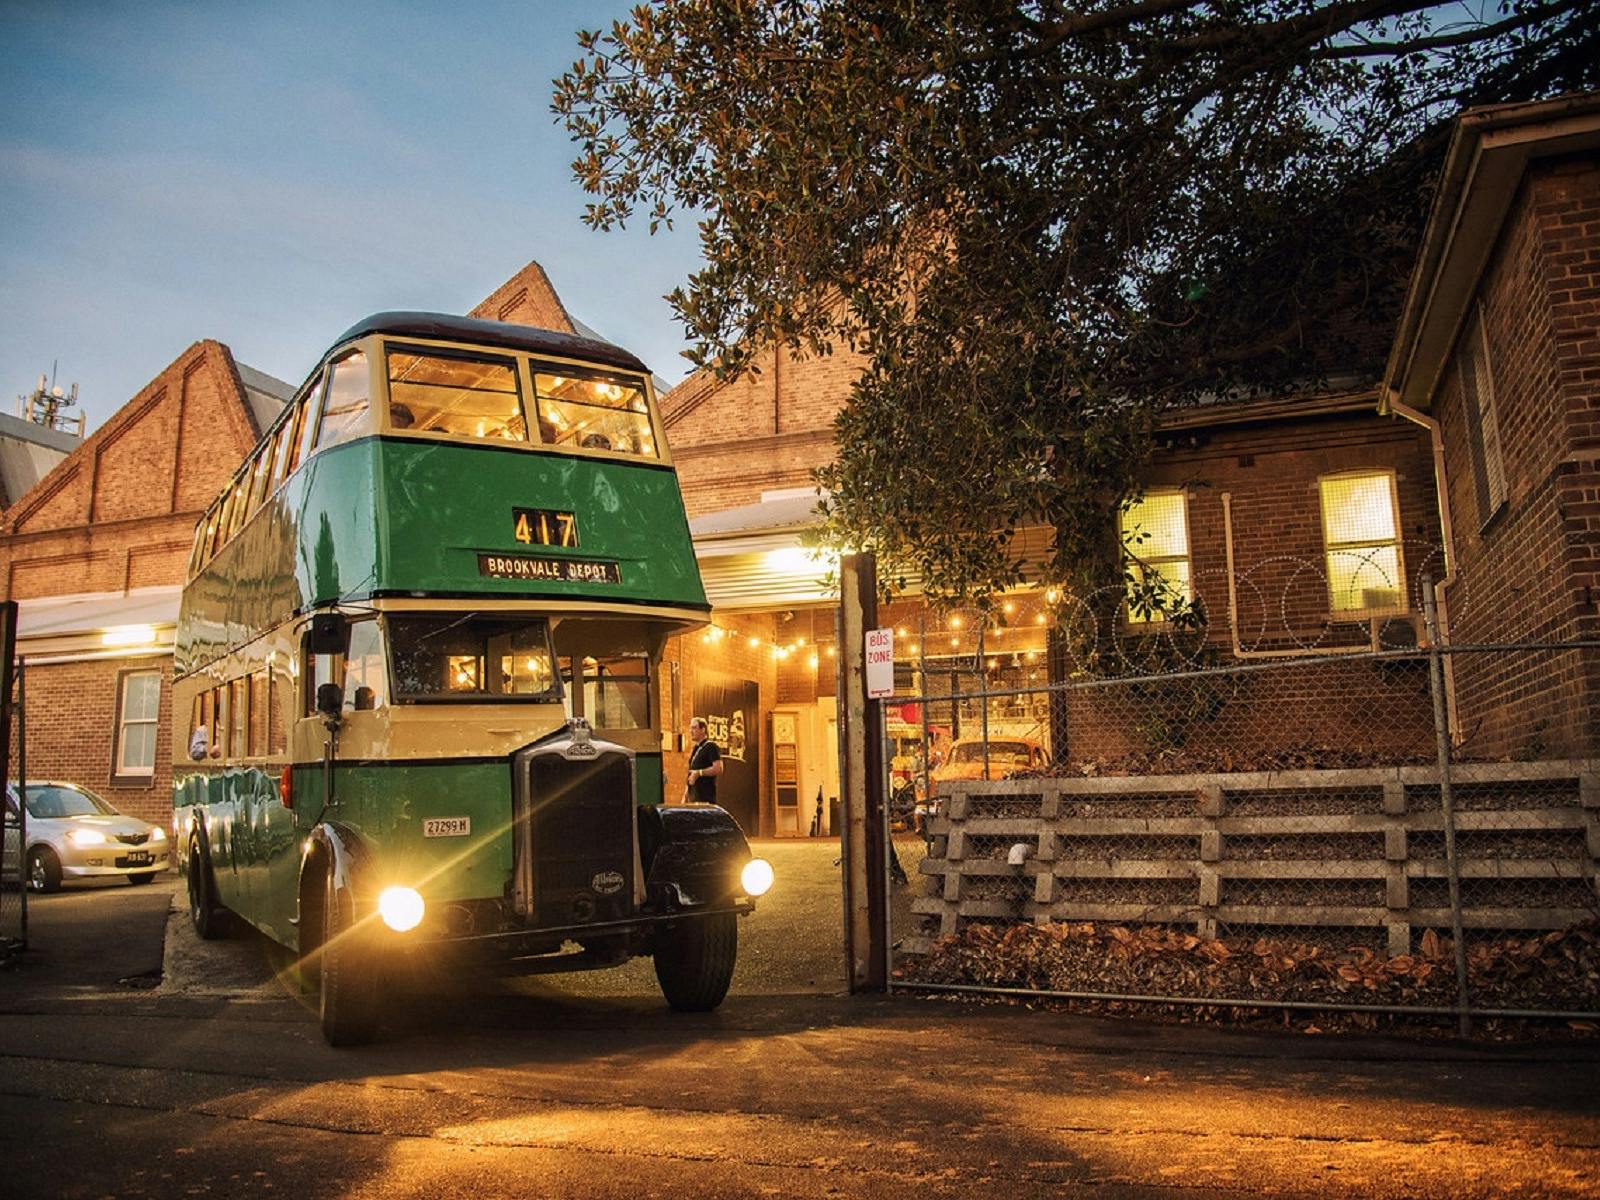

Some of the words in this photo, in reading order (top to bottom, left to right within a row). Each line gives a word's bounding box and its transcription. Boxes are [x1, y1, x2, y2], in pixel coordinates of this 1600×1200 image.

[515, 513, 574, 547] 417
[487, 557, 560, 577] BROOKVALE
[568, 563, 607, 579] DEPOT
[869, 634, 889, 647] BUS
[868, 650, 891, 664] ZONE
[707, 723, 728, 741] BUS
